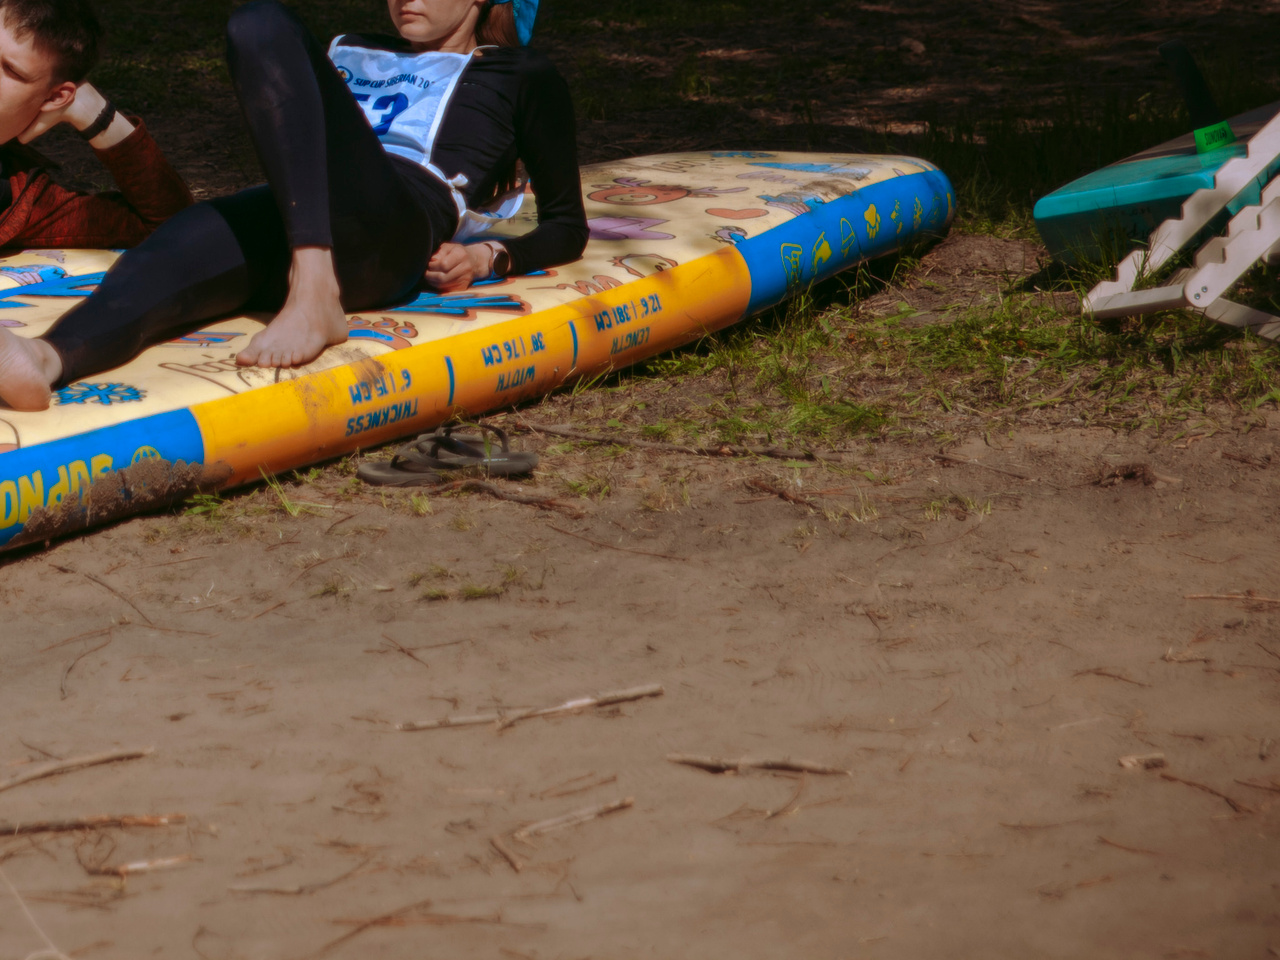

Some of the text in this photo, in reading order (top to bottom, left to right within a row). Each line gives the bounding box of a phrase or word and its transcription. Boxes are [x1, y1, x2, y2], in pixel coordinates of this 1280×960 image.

[353, 77, 371, 87] SUP
[370, 79, 386, 88] CUP
[593, 310, 612, 333] CM
[611, 304, 631, 326] 381
[503, 338, 520, 361] 76
[610, 326, 651, 355] LENGTH
[481, 344, 503, 368] CM
[374, 376, 389, 398] 15
[494, 365, 536, 394] WIDTH
[348, 381, 372, 406] CM
[345, 397, 419, 437] THICKNESS
